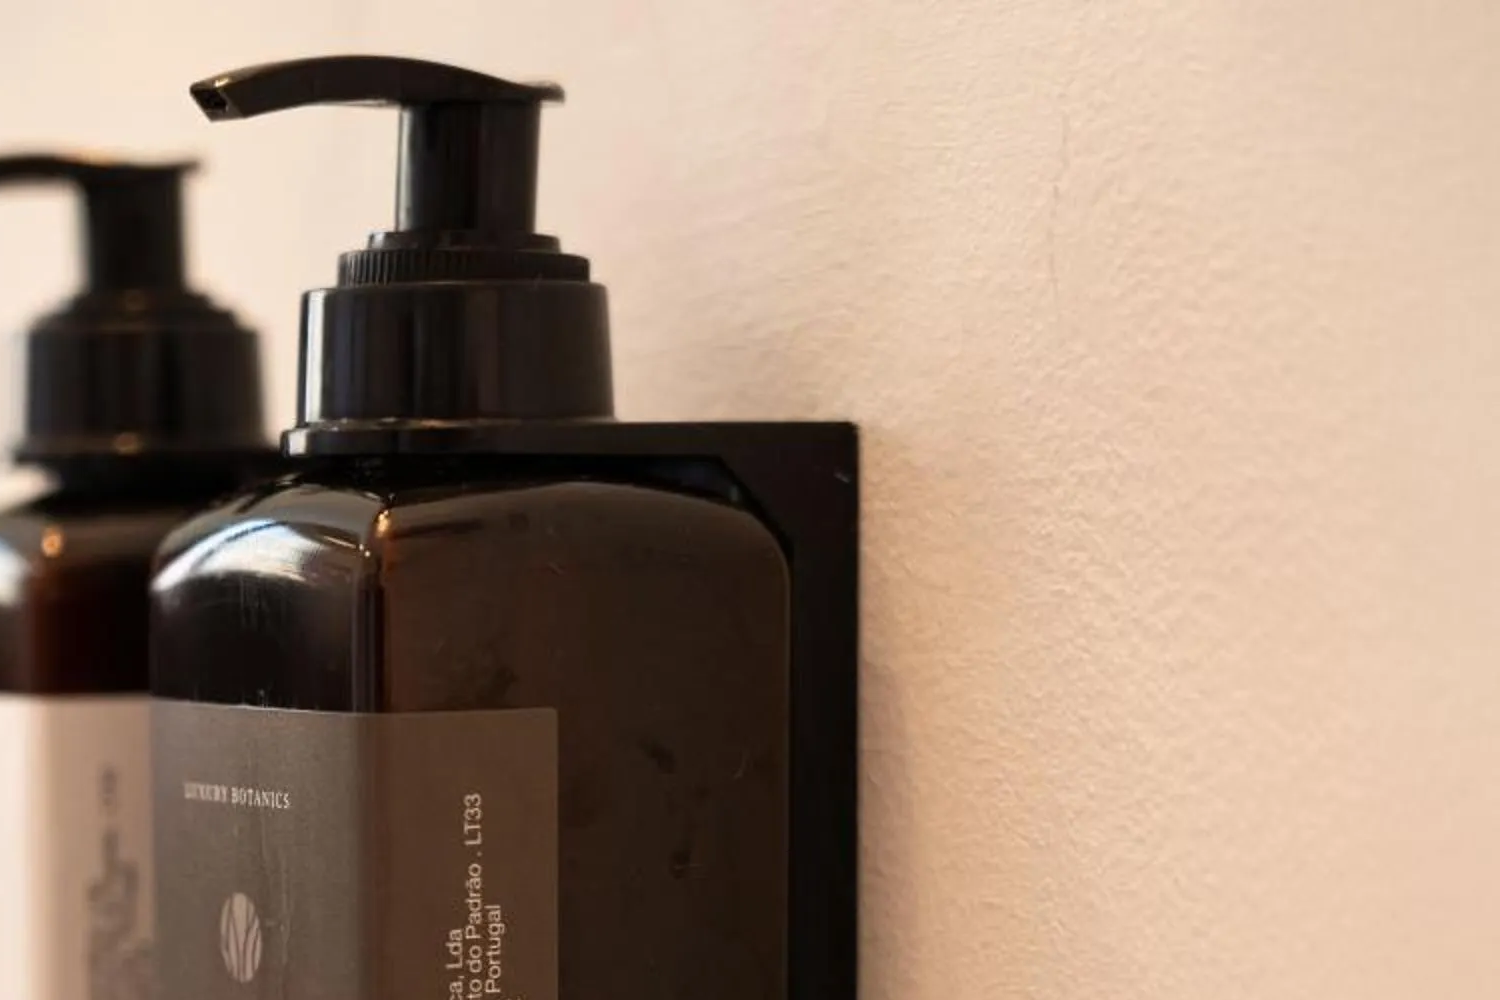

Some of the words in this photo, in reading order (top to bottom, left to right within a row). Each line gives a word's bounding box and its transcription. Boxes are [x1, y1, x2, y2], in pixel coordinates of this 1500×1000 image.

[230, 786, 292, 809] BOTANICS
[464, 793, 482, 846] LT33
[465, 863, 482, 939] Padrão
[445, 929, 463, 969] Lda
[466, 945, 483, 973] do
[484, 904, 505, 993] Portugal
